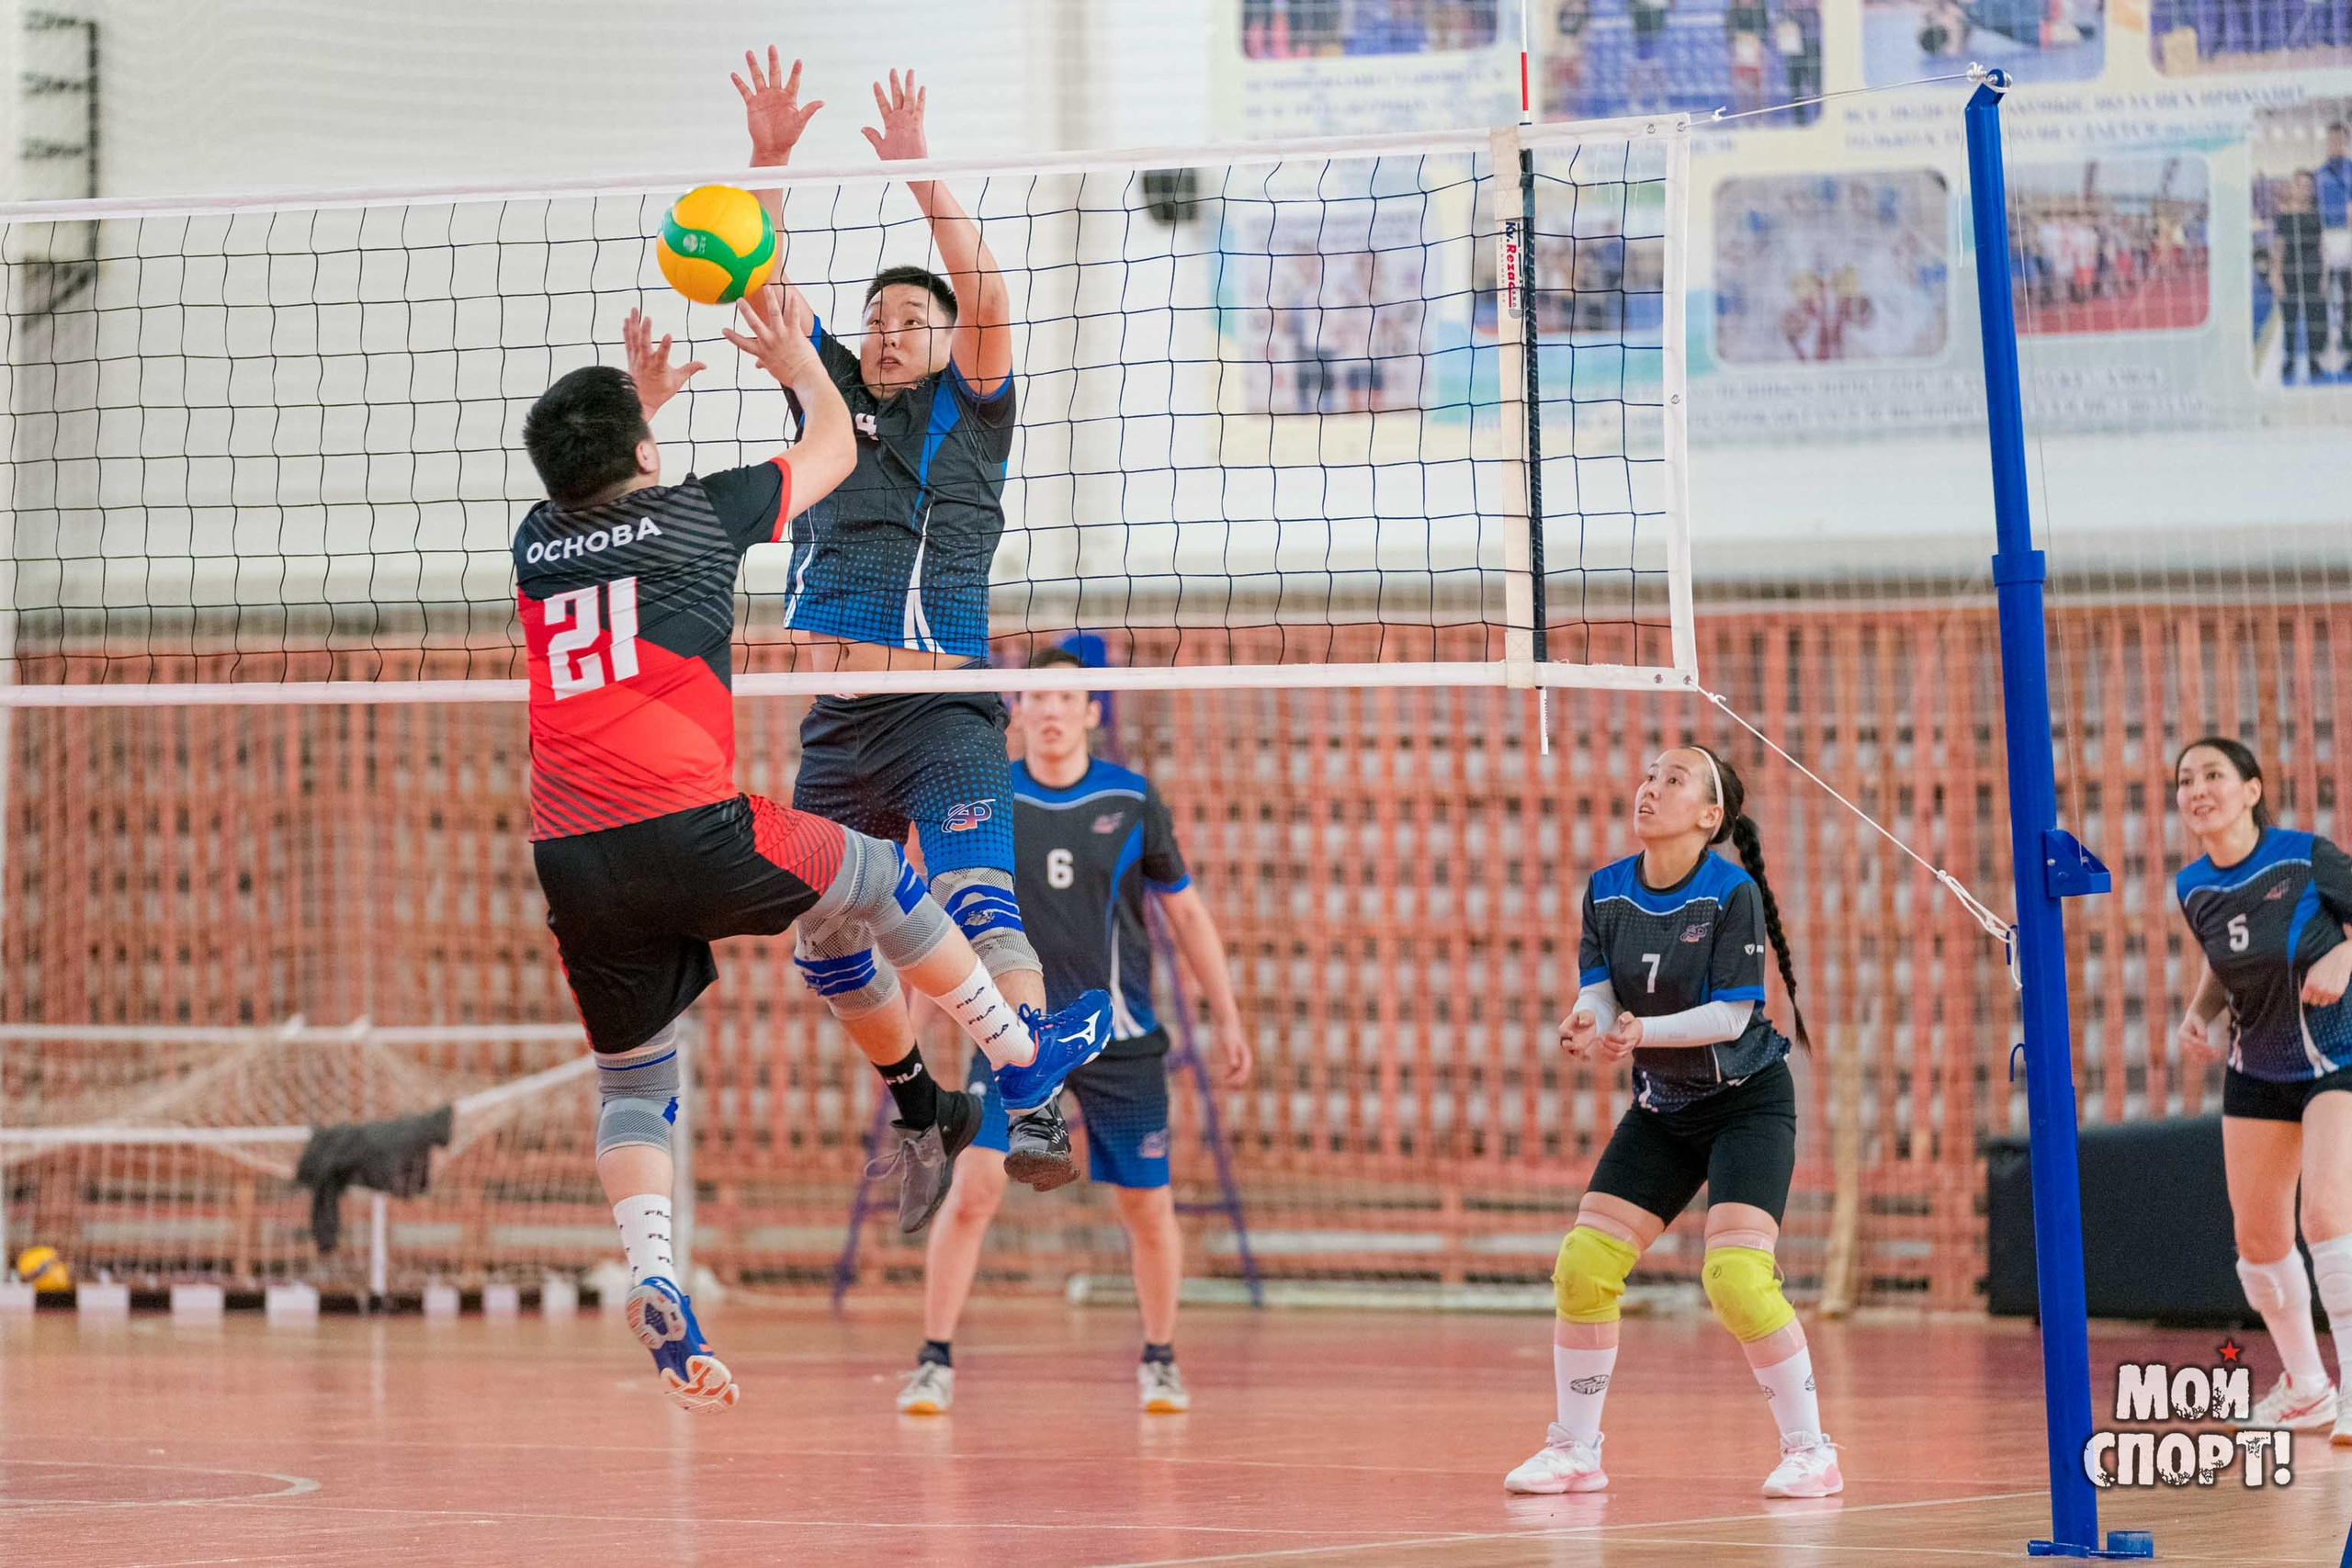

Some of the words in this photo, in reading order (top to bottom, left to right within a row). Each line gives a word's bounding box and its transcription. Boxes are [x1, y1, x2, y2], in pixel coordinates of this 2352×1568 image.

[526, 516, 662, 564] ОСНОВА
[543, 576, 639, 702] 21
[1046, 848, 1074, 889] 6
[2227, 913, 2249, 953] 5
[1641, 953, 1661, 994] 7
